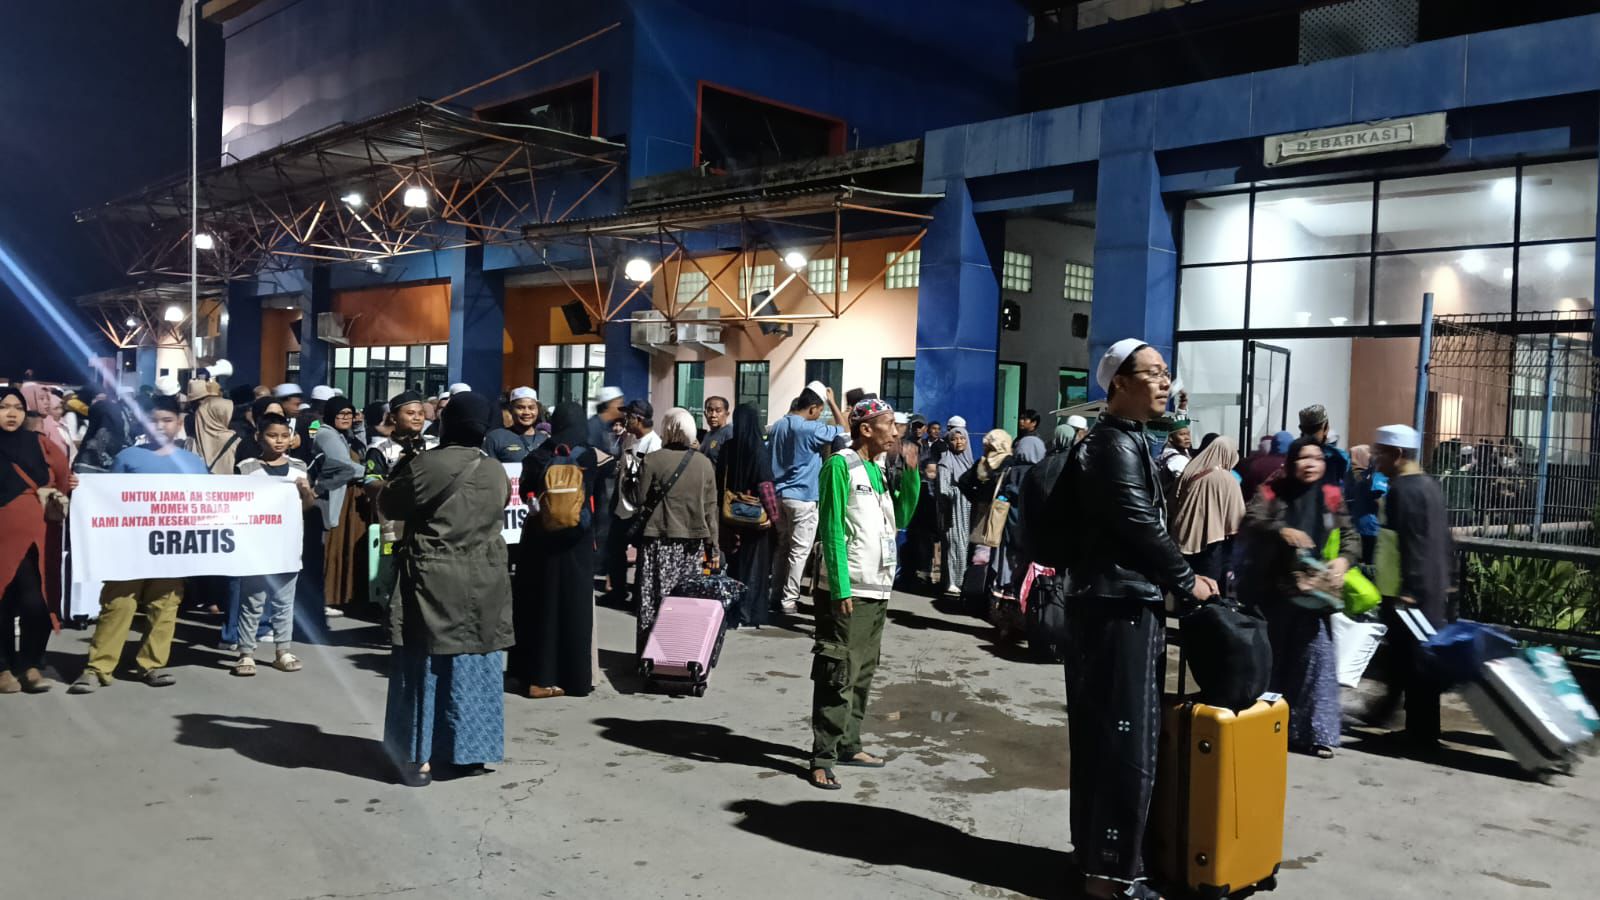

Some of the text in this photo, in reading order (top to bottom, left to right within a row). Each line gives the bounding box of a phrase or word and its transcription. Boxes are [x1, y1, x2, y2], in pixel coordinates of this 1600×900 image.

[1297, 129, 1399, 152] DEBARKASI
[121, 491, 157, 502] UNTUK
[151, 503, 230, 514] MOMEN 5 RAJAB
[92, 516, 119, 528] KAMI
[121, 516, 155, 527] ANTAR
[158, 515, 224, 526] KESEKU
[148, 528, 236, 555] GRATIS
